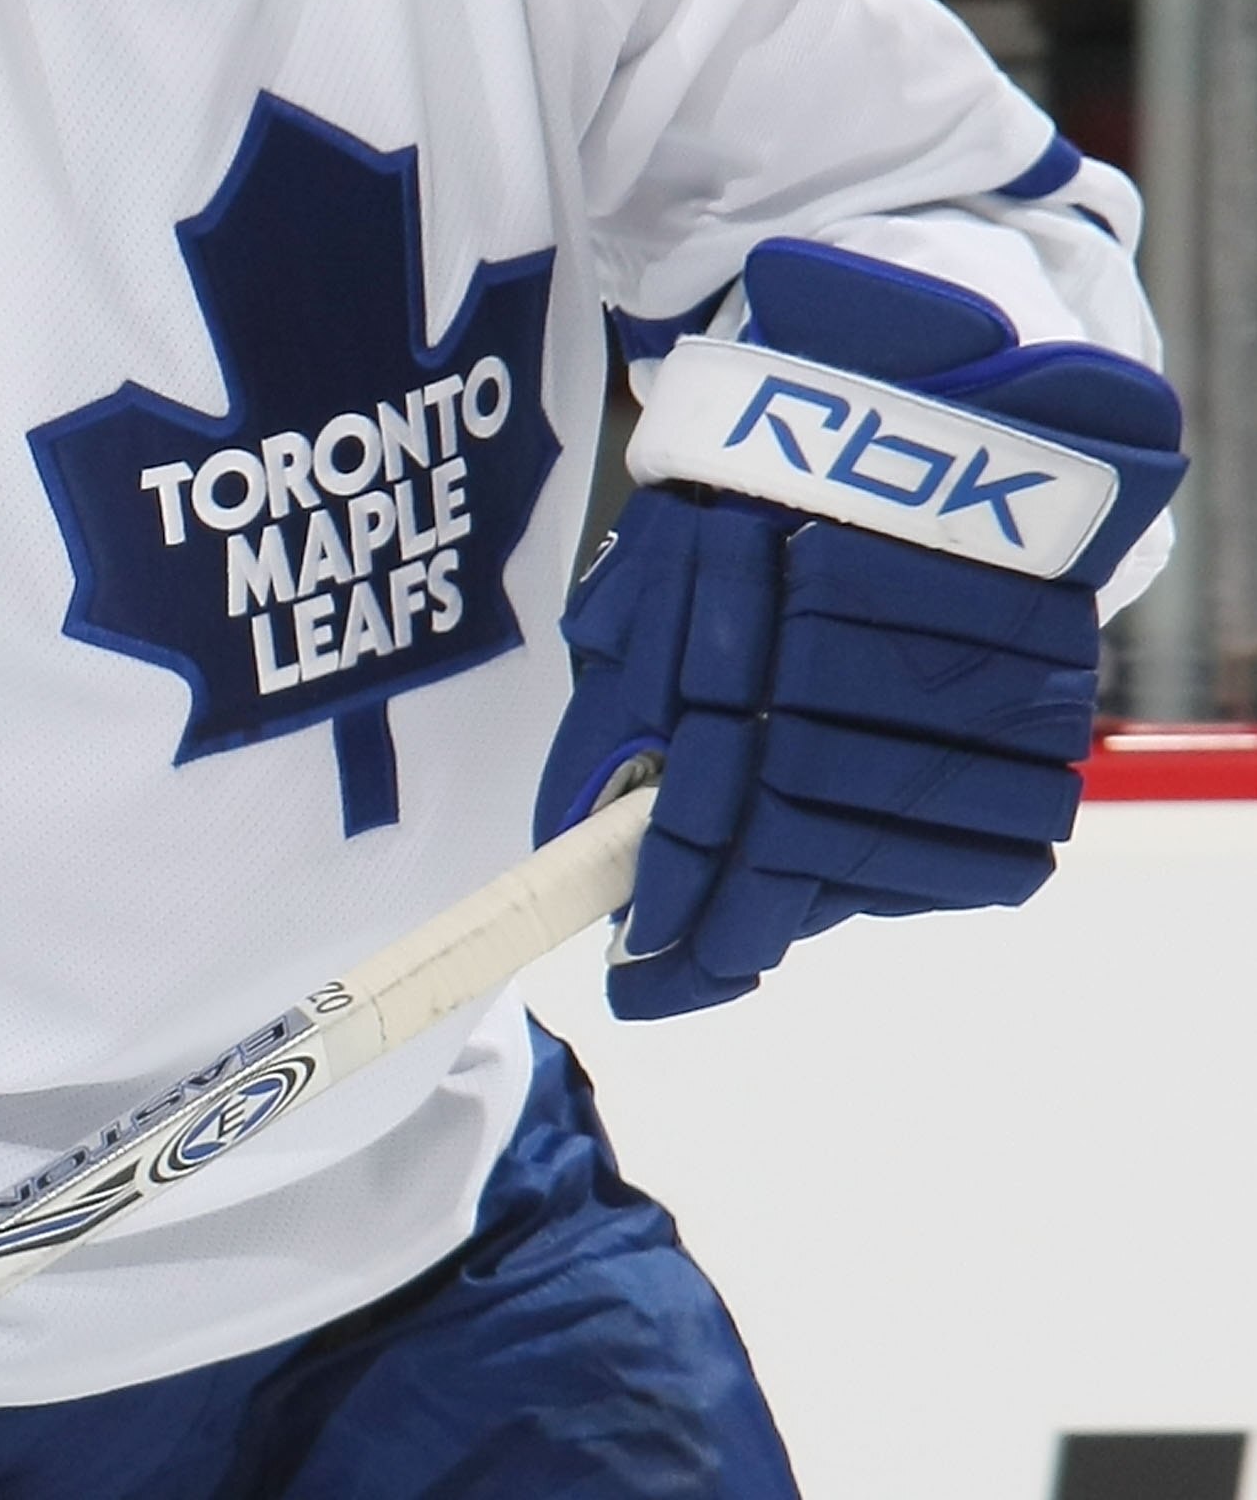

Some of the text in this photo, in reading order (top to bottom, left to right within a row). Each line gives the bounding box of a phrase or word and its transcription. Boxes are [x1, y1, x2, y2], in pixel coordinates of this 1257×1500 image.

[140, 355, 512, 547] TORONTO
[226, 456, 472, 618] MAPLE
[250, 548, 464, 695] LEAFS
